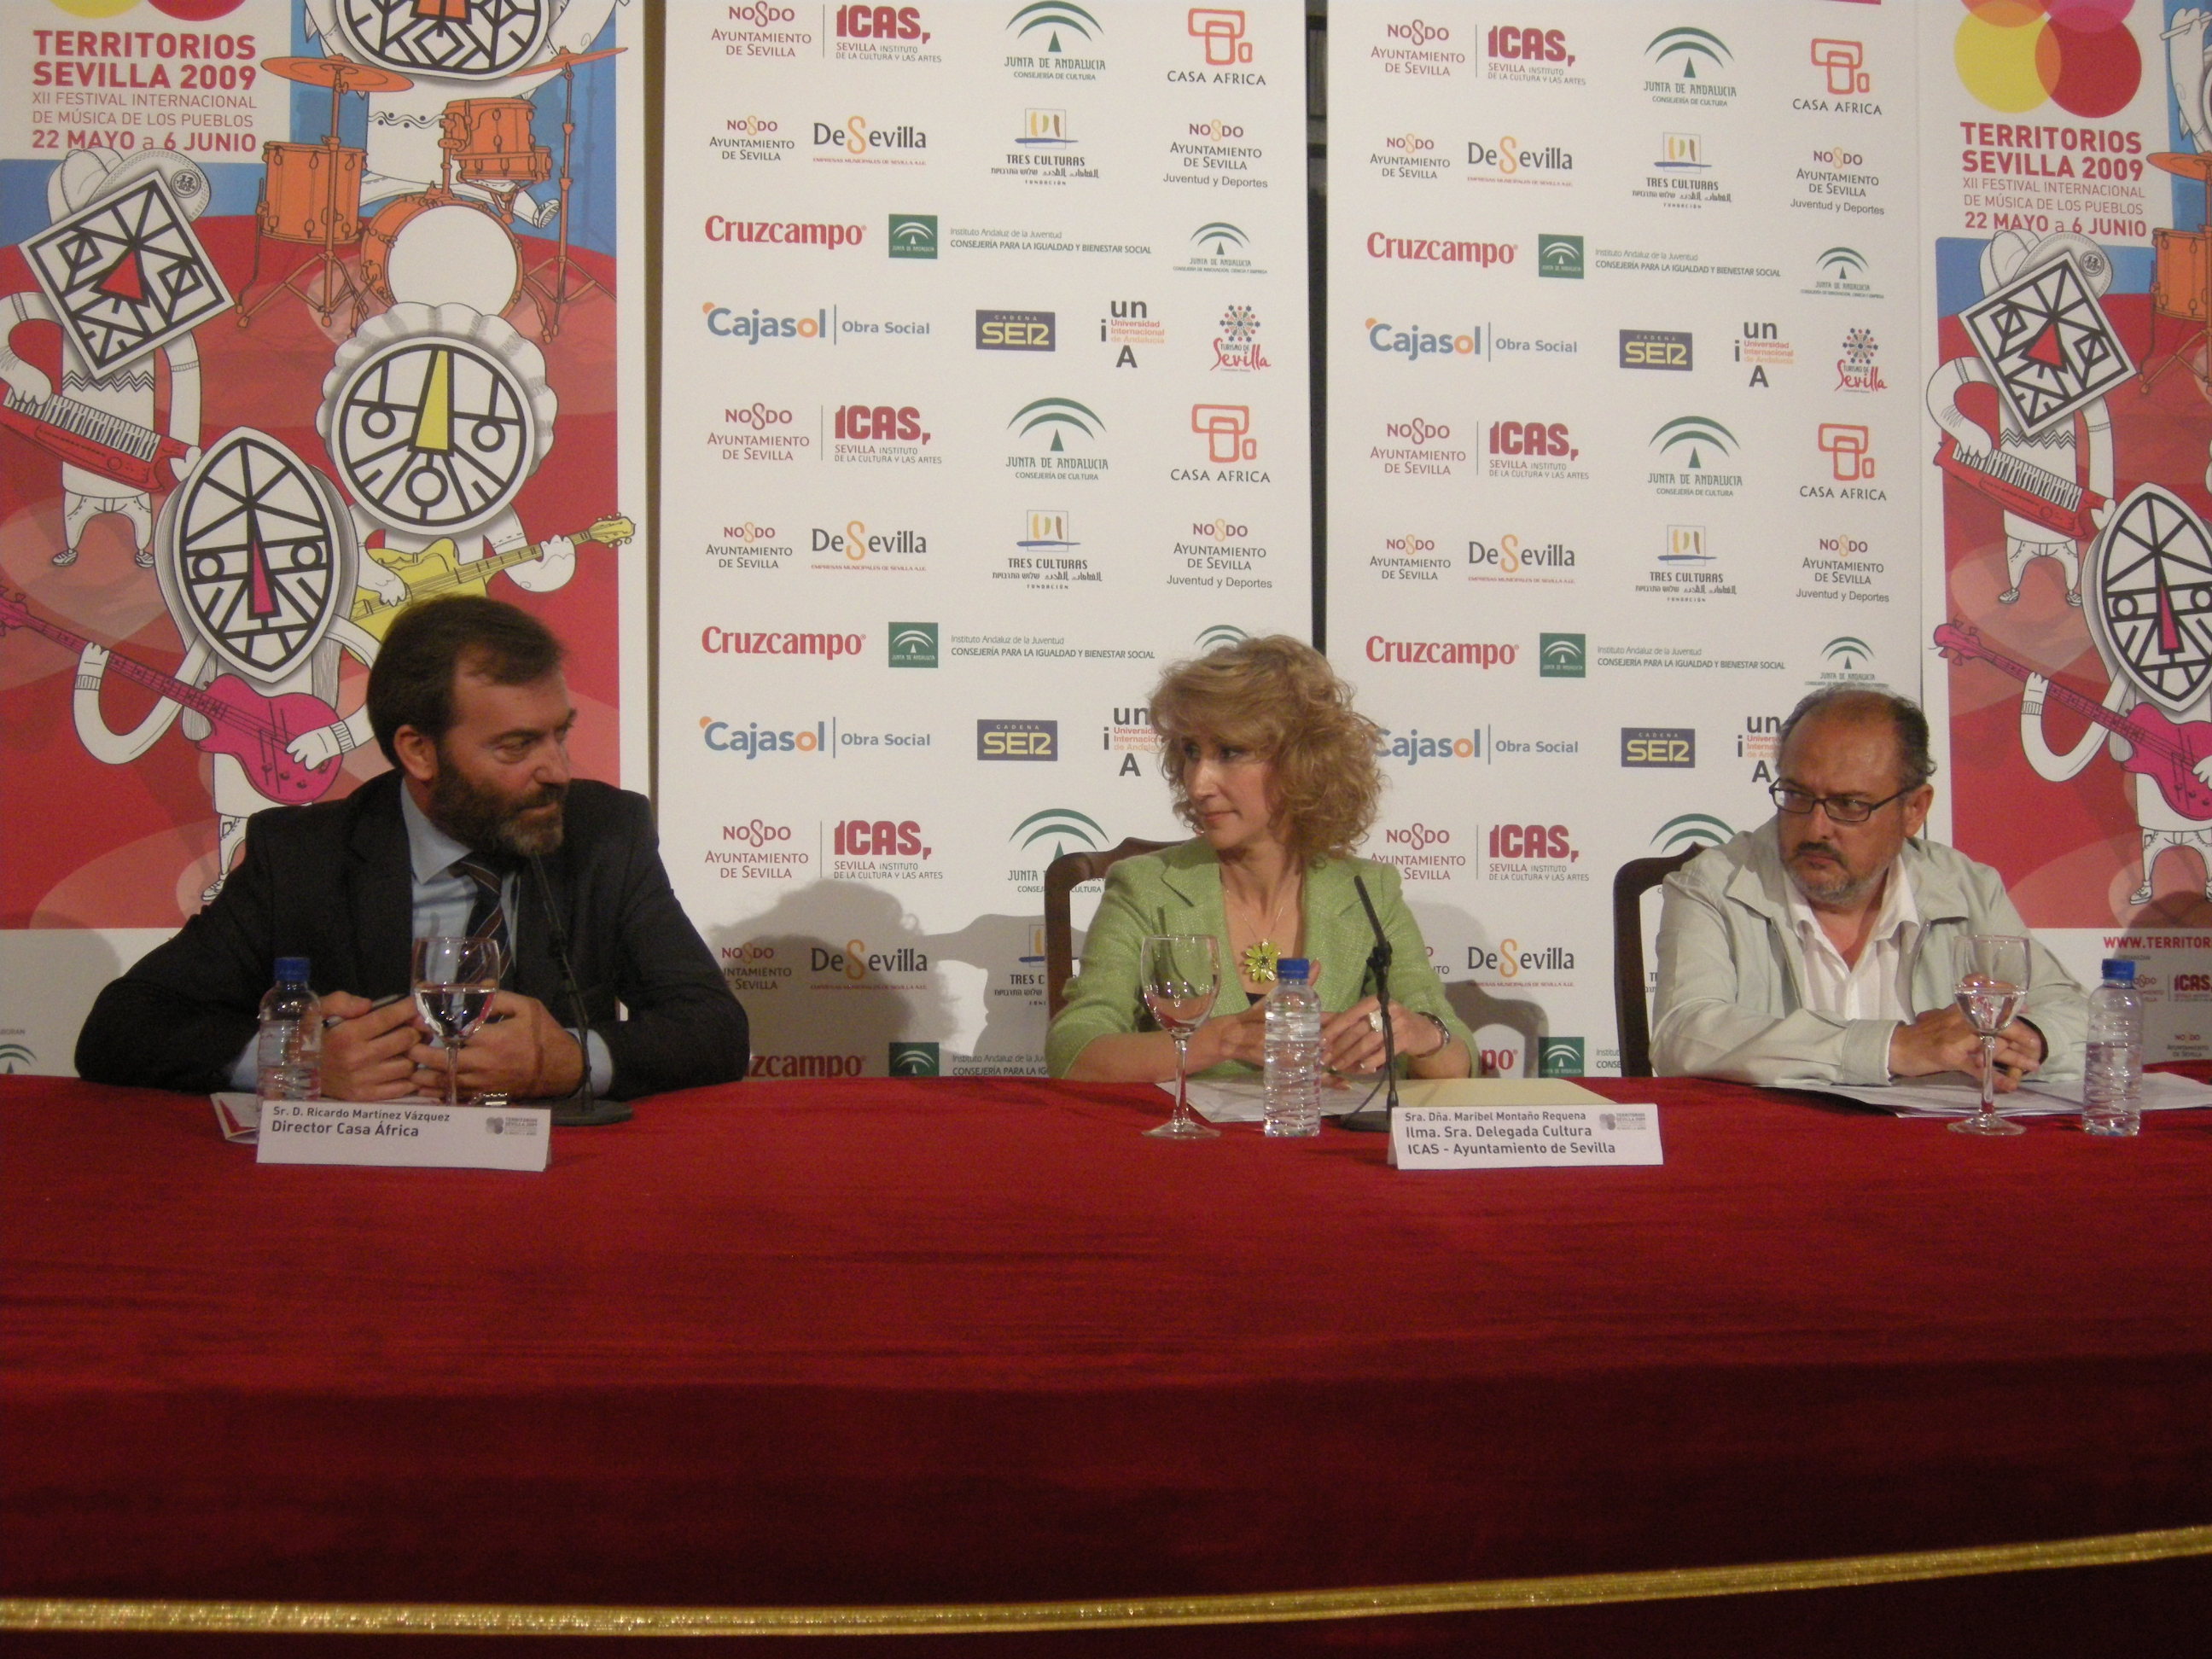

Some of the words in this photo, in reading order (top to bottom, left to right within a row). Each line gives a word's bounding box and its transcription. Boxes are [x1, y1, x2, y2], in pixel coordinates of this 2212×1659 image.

[33, 30, 255, 60] TERRITORIOS
[726, 45, 742, 55] DE
[747, 44, 795, 57] SEVILLA
[1004, 56, 1033, 67] JUNTA
[1039, 58, 1050, 67] DE
[1056, 58, 1105, 70] ANDALUCIA
[1385, 62, 1400, 73] DE
[1405, 61, 1450, 76] SEVILLA
[32, 61, 171, 88] SEVILLA
[180, 65, 256, 90] 2009
[1167, 70, 1206, 84] CASA
[1214, 72, 1266, 85] AFRICA
[32, 92, 49, 104] XII
[55, 92, 126, 106] FESTIVAL
[132, 94, 257, 108] INTERNACIONAL
[1792, 99, 1828, 112] CASA
[1835, 102, 1882, 115] AFRICA
[33, 111, 52, 123] DE
[58, 108, 116, 125] MÚSICA
[122, 113, 141, 125] DE
[148, 114, 176, 125] LOS
[182, 114, 253, 127] PUEBLOS
[32, 130, 59, 148] 22
[67, 131, 134, 150] MAYO
[143, 137, 154, 149] a
[164, 132, 176, 151] 6
[183, 132, 256, 152] JUNIO
[1960, 121, 2141, 154] TERRITORIOS
[1006, 154, 1030, 165] TRES
[1034, 155, 1085, 166] CULTURAS
[1962, 149, 2075, 178] SEVILLA
[2082, 157, 2143, 181] 2009
[1163, 173, 1209, 185] Juventud
[1213, 178, 1218, 186] y
[1222, 178, 1268, 189] Deportes
[1964, 178, 1977, 189] XII
[1982, 178, 2040, 193] FESTIVAL
[2045, 182, 2145, 198] INTERNACIONAL
[1965, 195, 1980, 206] DE
[1985, 193, 2033, 209] MÚSICA
[2037, 199, 2052, 210] DE
[2058, 200, 2081, 212] LOS
[2086, 201, 2143, 214] PUEBLOS
[705, 215, 863, 249] Cruzcampo
[1965, 212, 1987, 229] 22
[1994, 212, 2048, 231] MAYO
[2055, 220, 2064, 232] a
[2072, 218, 2082, 233] 6
[2088, 218, 2146, 237] JUNIO
[1000, 241, 1019, 250] PARA
[1022, 242, 1031, 250] LA
[1033, 242, 1074, 251] IGUALDAD
[1082, 244, 1122, 253] BIENESTAR
[1125, 245, 1151, 254] SOCIAL
[1367, 231, 1514, 268] Cruzcampo
[707, 307, 826, 345] Cajasol
[842, 321, 879, 334] Obra
[885, 322, 929, 335] Social
[982, 323, 1049, 345] SER
[1369, 323, 1481, 360] Cajasol
[1495, 338, 1530, 351] Obra
[1536, 341, 1577, 352] Social
[1210, 338, 1271, 370] Sevilla
[1625, 342, 1687, 365] SER
[723, 449, 739, 460] DE
[744, 447, 793, 461] SEVILLA
[835, 445, 875, 454] SEVILLA
[1171, 469, 1210, 481] CASA
[1217, 470, 1270, 482] AFRICA
[1384, 463, 1400, 473] DE
[1405, 462, 1451, 475] SEVILLA
[1648, 473, 1675, 484] JUNTA
[1680, 474, 1691, 485] DE
[1695, 474, 1743, 486] ANDALUCIA
[1800, 486, 1834, 498] CASA
[1841, 487, 1886, 501] AFRICA
[719, 559, 733, 568] DE
[737, 556, 778, 568] SEVILLA
[1008, 558, 1032, 568] TRES
[1036, 558, 1087, 570] CULTURAS
[1188, 558, 1202, 568] DE
[1207, 558, 1251, 570] SEVILLA
[1167, 574, 1214, 585] Juventud
[1217, 578, 1222, 587] y
[1226, 577, 1272, 589] Deportes
[701, 626, 862, 661] Cruzcampo
[1365, 635, 1516, 670] Cruzcampo
[704, 721, 824, 760] Cajasol
[841, 733, 879, 745] Obra
[885, 733, 930, 746] Social
[983, 732, 1051, 754] SER
[1495, 740, 1530, 752] Obra
[1536, 742, 1578, 753] Social
[1627, 740, 1689, 761] SER
[720, 868, 737, 878] DE
[742, 865, 792, 878] SEVILLA
[1404, 867, 1451, 880] SEVILLA
[273, 1106, 289, 1116] Sr.
[293, 1108, 303, 1116] D.
[307, 1108, 349, 1117] Ricardo
[353, 1109, 401, 1120] Martínez
[405, 1110, 450, 1122] Vázquez
[1405, 1112, 1426, 1121] Sra.
[1429, 1111, 1451, 1121] Dña.
[1454, 1111, 1493, 1121] Maribel
[1496, 1110, 1540, 1121] Montaño
[1543, 1110, 1586, 1122] Requena
[271, 1120, 332, 1134] Director
[336, 1122, 370, 1136] Casa
[375, 1121, 419, 1137] África
[1406, 1126, 1440, 1138] Ilma.
[1444, 1126, 1471, 1138] Sra.
[1476, 1126, 1539, 1140] Delegada
[1543, 1125, 1592, 1137] Cultura
[1409, 1143, 1439, 1155] ICAS
[1453, 1143, 1546, 1157] Ayuntamiento
[1551, 1143, 1567, 1154] de
[1571, 1142, 1615, 1154] Sevilla
